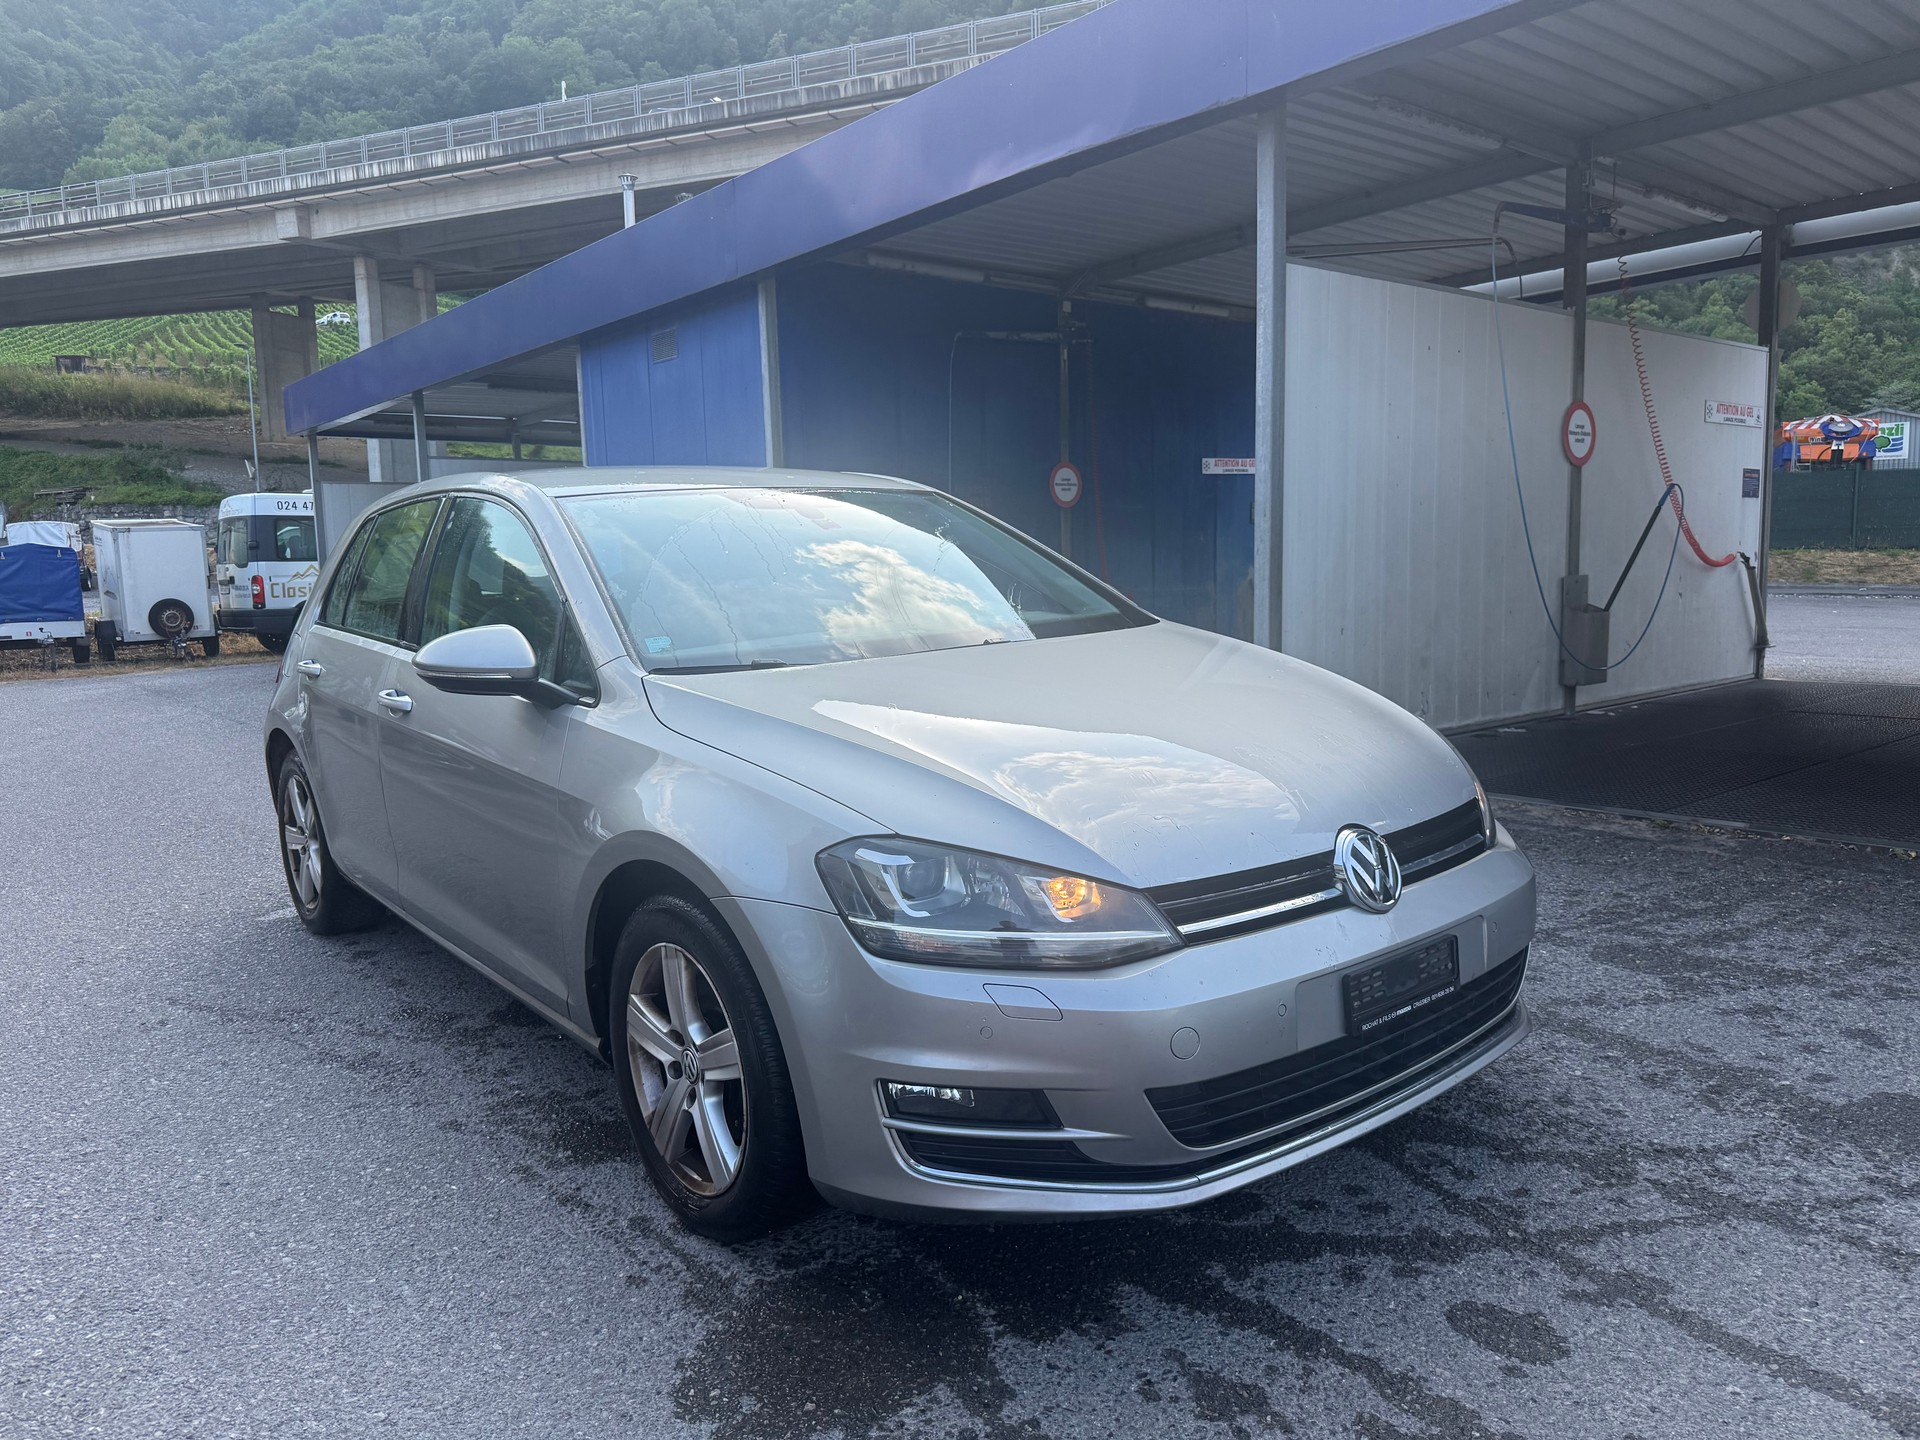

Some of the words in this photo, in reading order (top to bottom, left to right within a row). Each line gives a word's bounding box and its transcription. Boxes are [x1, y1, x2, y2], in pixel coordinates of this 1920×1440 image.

[1716, 403, 1739, 416] ATTENTION
[1879, 424, 1904, 436] nzli
[1214, 459, 1239, 467] ATTENTION
[277, 501, 297, 510] 024
[303, 501, 314, 510] 47
[270, 583, 312, 598] Closi
[1382, 1013, 1392, 1023] FILS
